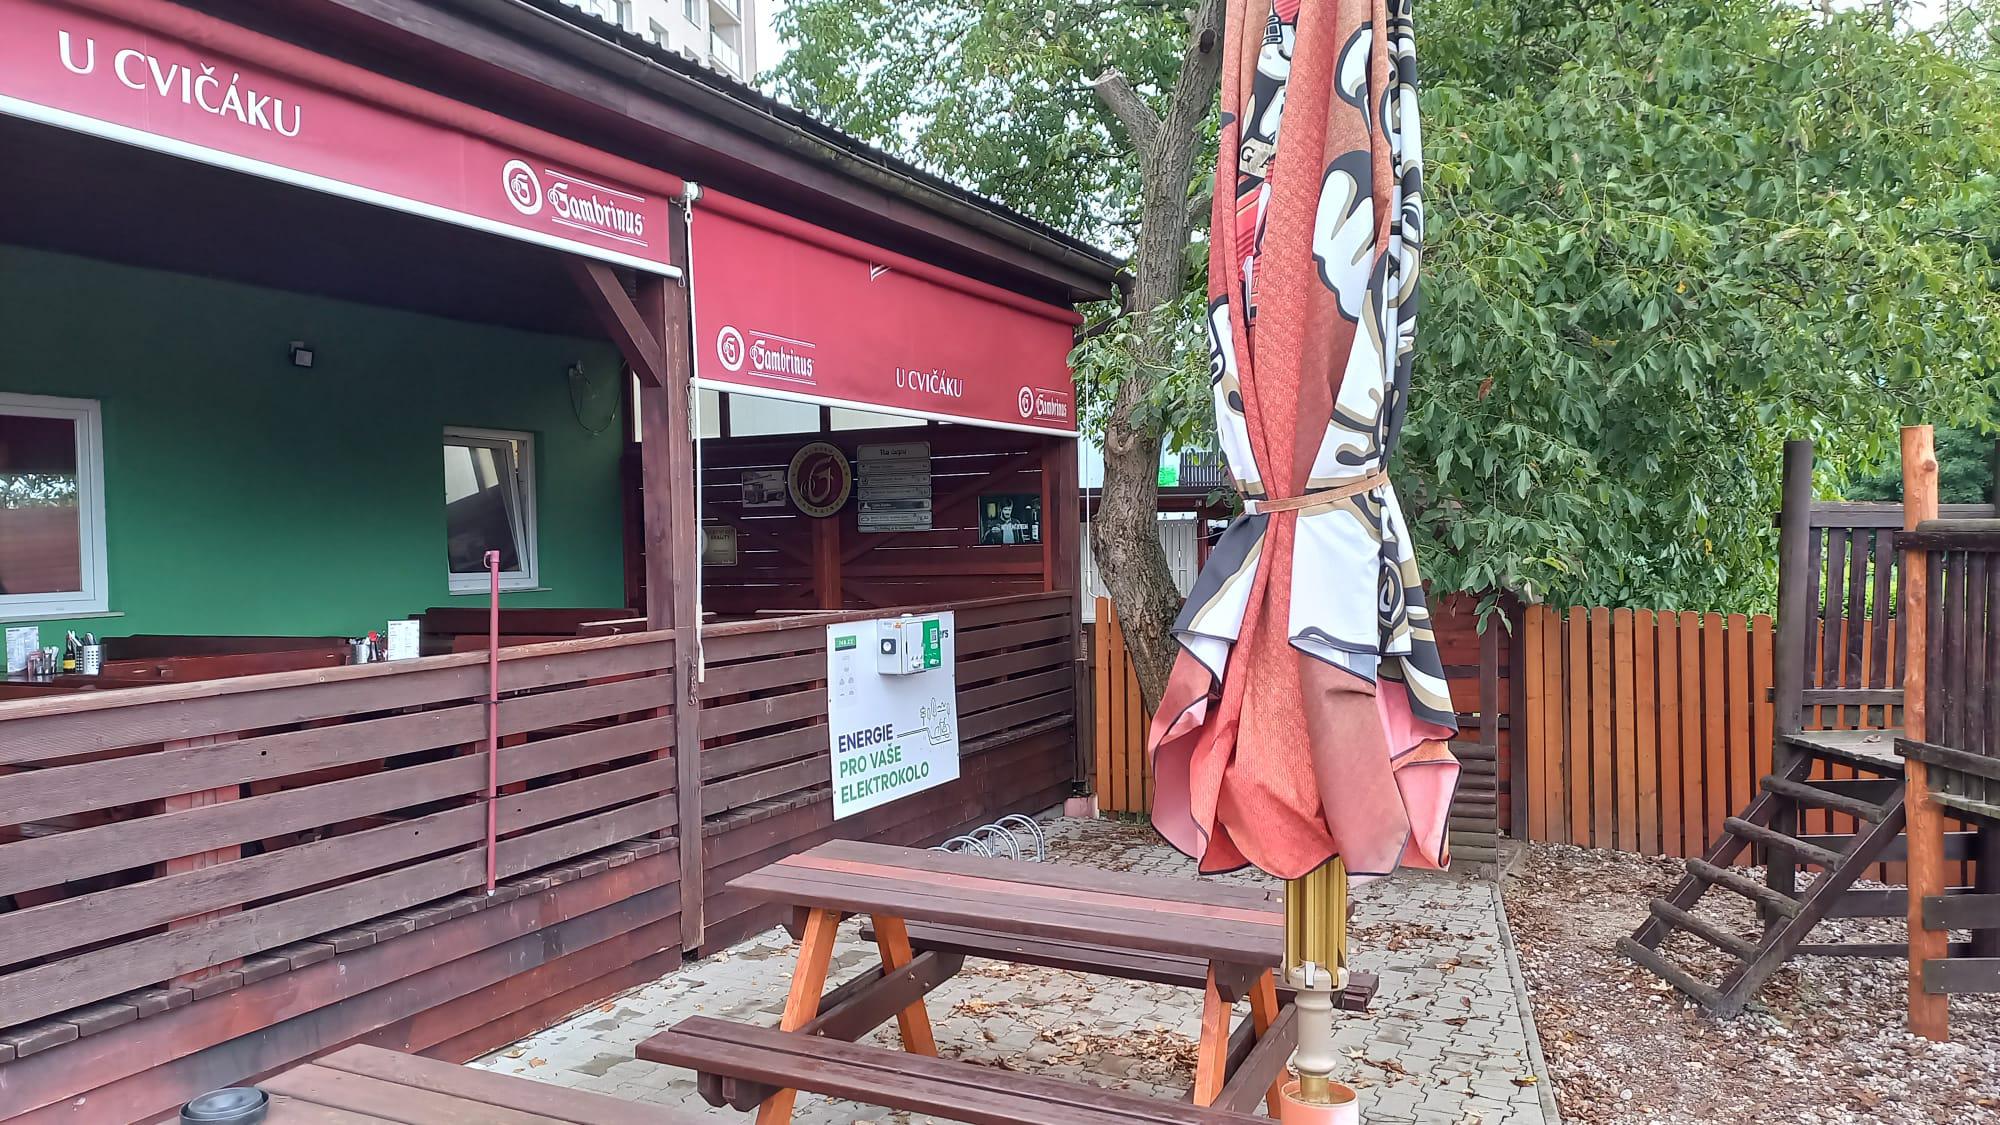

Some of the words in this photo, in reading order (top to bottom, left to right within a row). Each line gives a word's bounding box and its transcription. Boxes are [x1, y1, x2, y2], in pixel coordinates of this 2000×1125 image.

[58, 29, 95, 75] U
[114, 48, 301, 137] CVIČÁKU
[548, 182, 644, 236] Gambrinus
[750, 339, 815, 377] Gambrinus
[896, 367, 905, 388] U
[908, 369, 963, 398] CVIČÁKU
[1035, 393, 1067, 418] Gambrinus
[838, 723, 894, 753] ENERGIE
[840, 755, 867, 779] PRO
[870, 742, 902, 769] VAŠE
[841, 761, 929, 804] ELEKTROKOLO
